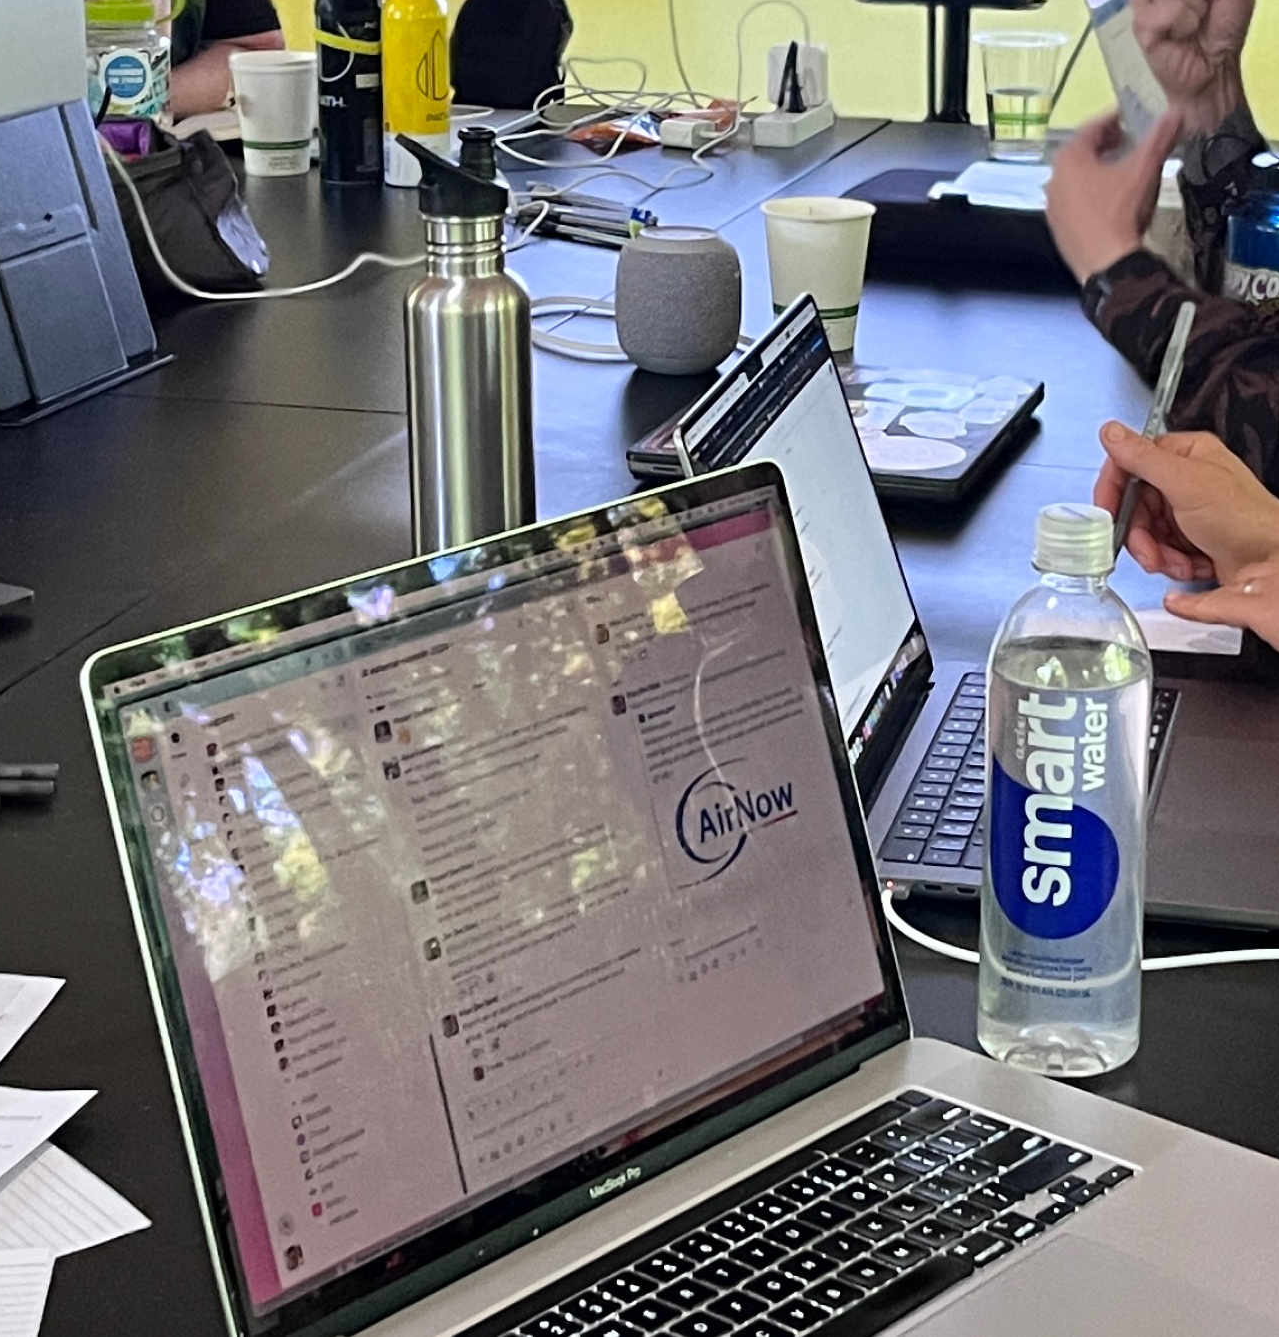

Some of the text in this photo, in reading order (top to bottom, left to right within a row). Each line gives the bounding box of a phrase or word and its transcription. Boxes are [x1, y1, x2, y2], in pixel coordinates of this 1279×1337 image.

[1080, 696, 1110, 793] water
[699, 781, 794, 845] AirNow
[1021, 692, 1078, 908] smart
